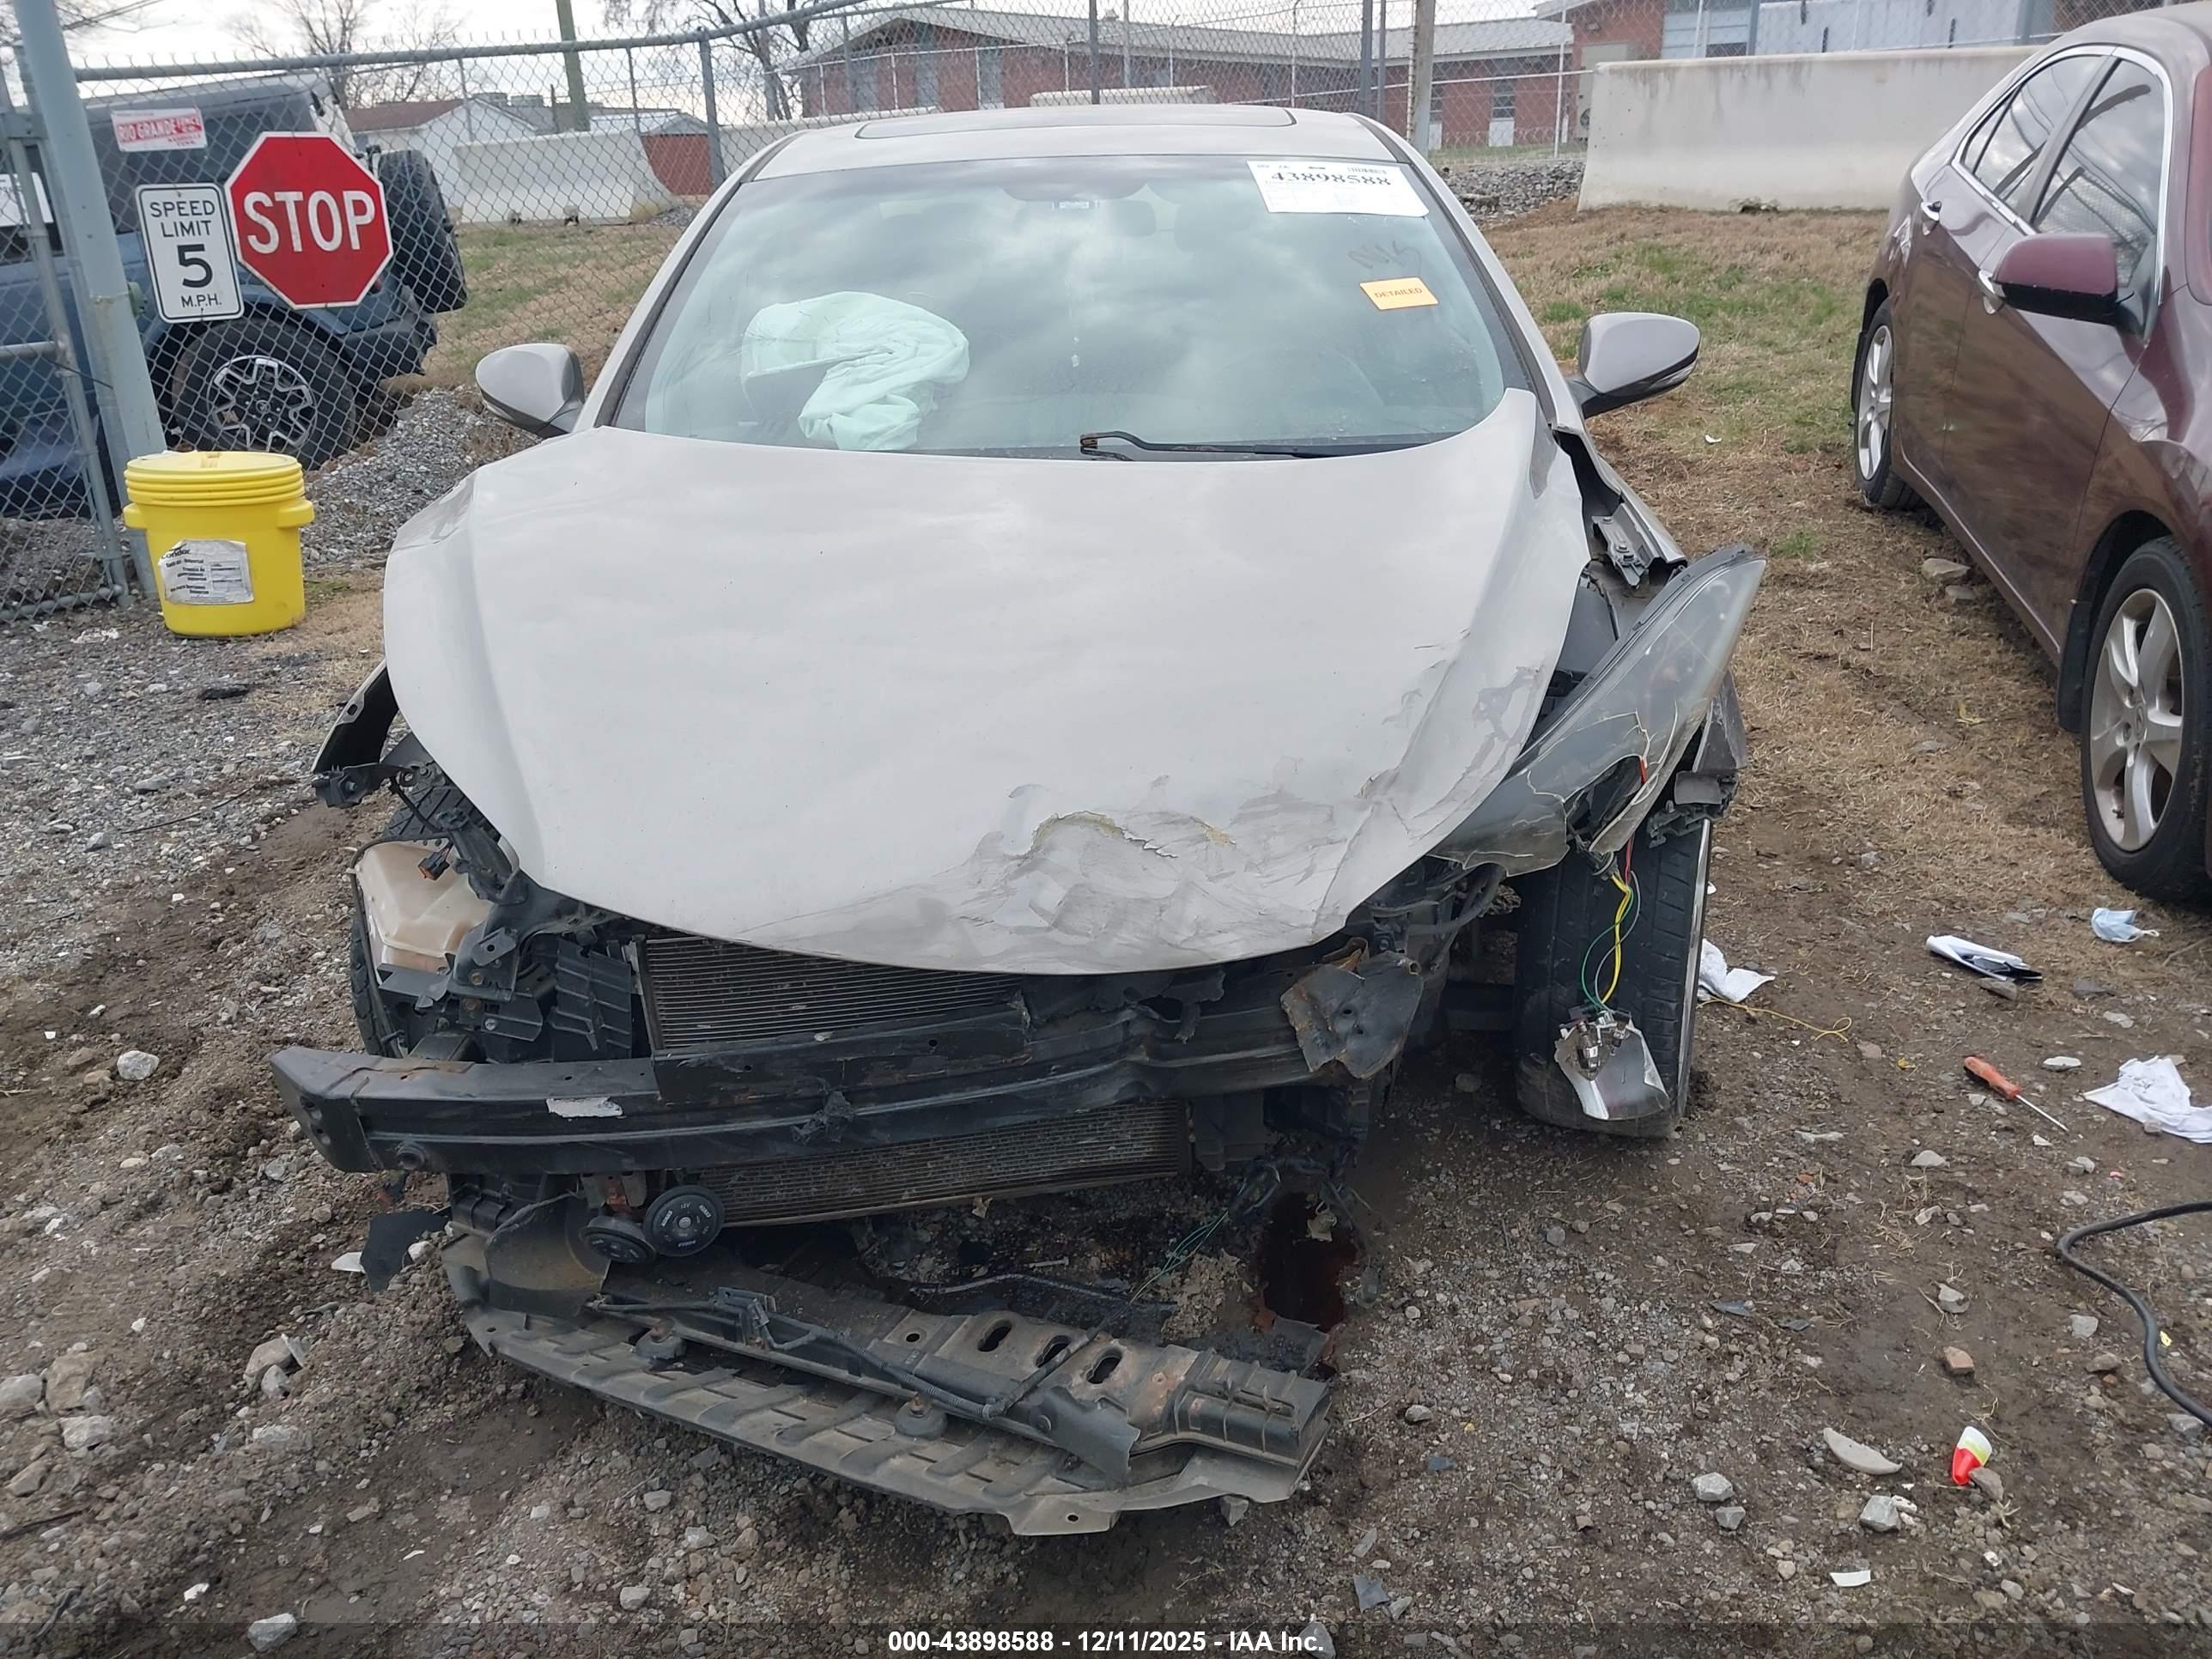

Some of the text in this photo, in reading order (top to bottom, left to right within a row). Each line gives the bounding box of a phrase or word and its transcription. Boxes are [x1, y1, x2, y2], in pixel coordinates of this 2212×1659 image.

[149, 200, 216, 218] SPEED
[161, 220, 212, 238] LIMIT
[243, 190, 375, 254] STOP
[177, 244, 213, 288] 5
[180, 294, 222, 308] M.P.H.
[1374, 288, 1423, 299] DETAILED
